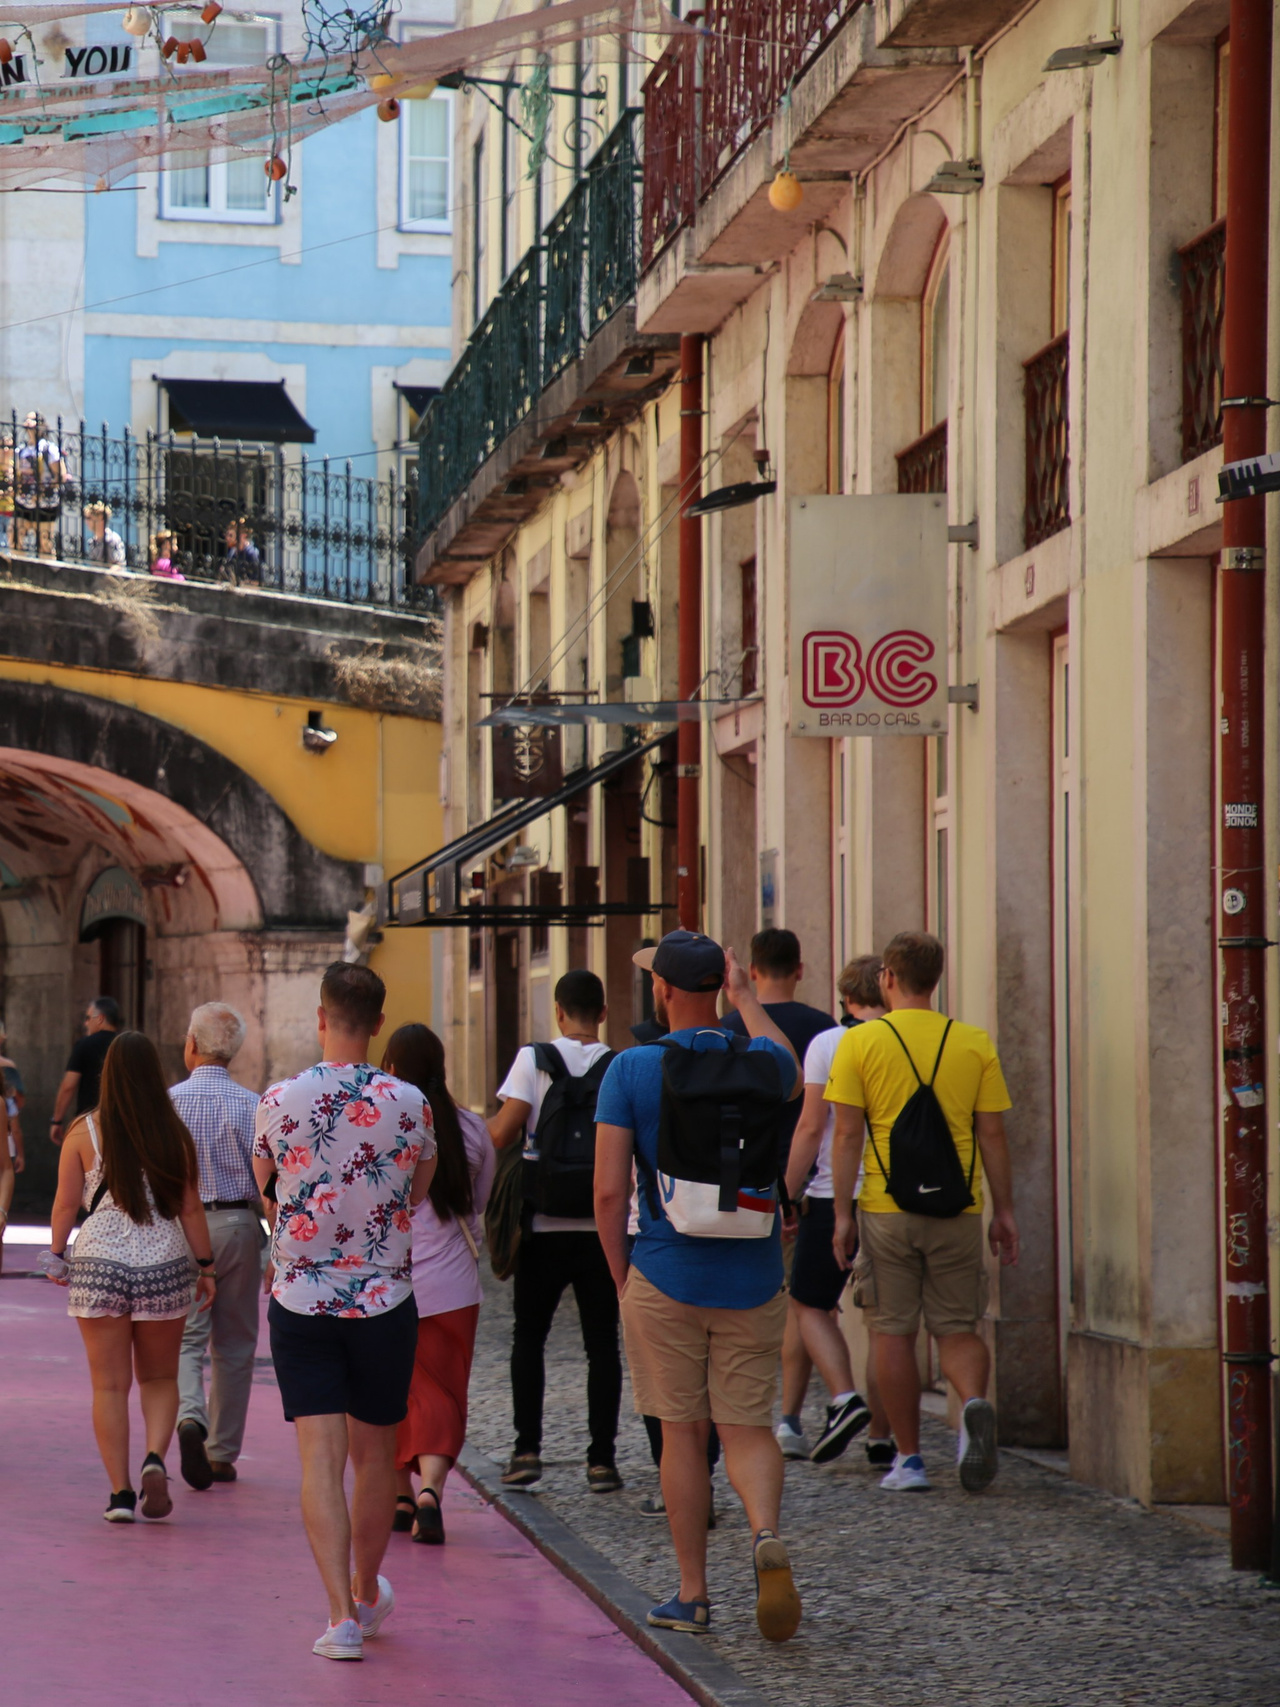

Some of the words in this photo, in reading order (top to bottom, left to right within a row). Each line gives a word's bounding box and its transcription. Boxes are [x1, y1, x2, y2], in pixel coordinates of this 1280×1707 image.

[65, 46, 132, 77] YOU
[802, 630, 938, 709] BC
[819, 712, 853, 726] BAR
[856, 712, 881, 726] DO
[884, 712, 921, 726] CAIS
